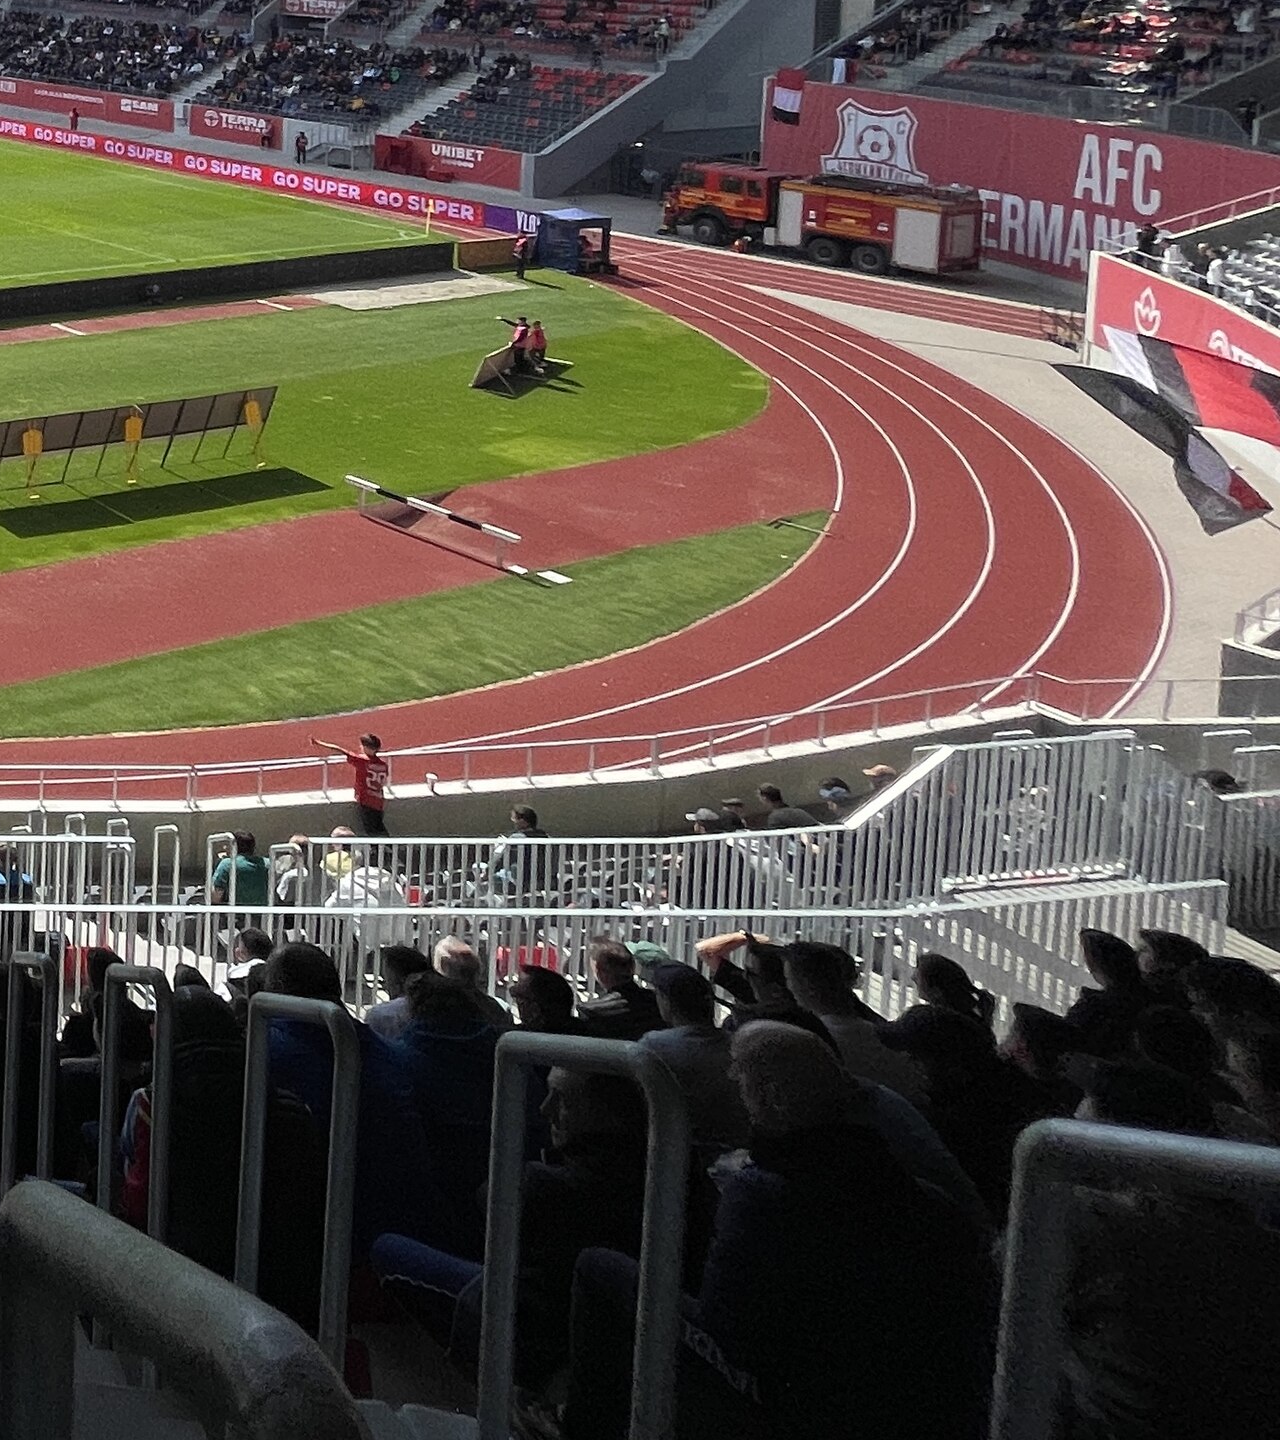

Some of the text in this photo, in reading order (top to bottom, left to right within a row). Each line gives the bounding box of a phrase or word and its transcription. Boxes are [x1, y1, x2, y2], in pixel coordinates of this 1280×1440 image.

[220, 112, 267, 128] TERRA
[34, 128, 96, 149] GO SUPER
[104, 141, 173, 164] GO SUPER
[431, 143, 484, 162] UNIBET
[184, 155, 262, 182] GO SUPER
[1074, 133, 1163, 216] AFC
[273, 171, 361, 201] GO SUPER
[374, 190, 474, 222] GO SUPER
